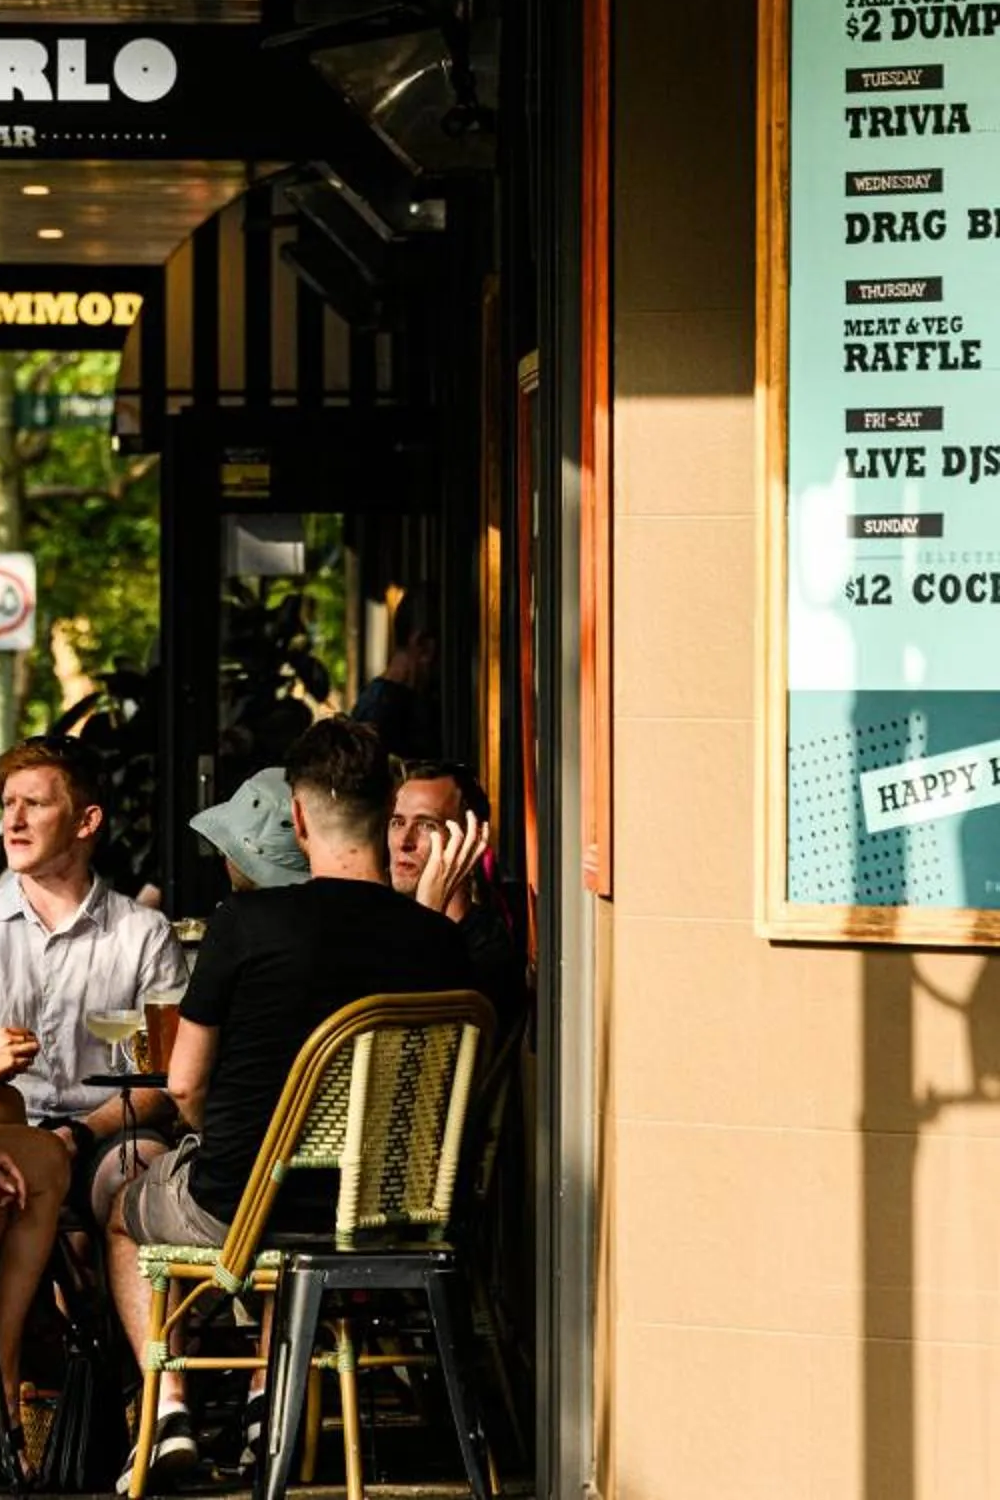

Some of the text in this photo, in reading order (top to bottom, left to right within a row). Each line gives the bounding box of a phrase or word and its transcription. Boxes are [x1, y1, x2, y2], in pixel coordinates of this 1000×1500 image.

[846, 2, 1000, 42] $2 DUMP
[861, 69, 923, 88] TUESDAY
[845, 103, 972, 139] TRIVIA
[854, 174, 932, 192] WEDNESDAY
[845, 207, 1000, 245] DRAG B
[858, 282, 927, 299] THURSDAY
[844, 318, 901, 337] MEAT
[921, 316, 963, 335] VEG
[844, 340, 982, 373] RAFFLE
[864, 411, 923, 429] FRI-SAT
[845, 445, 1000, 485] LIVE DJS
[864, 517, 919, 534] SUNDAY
[845, 573, 893, 606] $12
[878, 763, 979, 814] HAPPY
